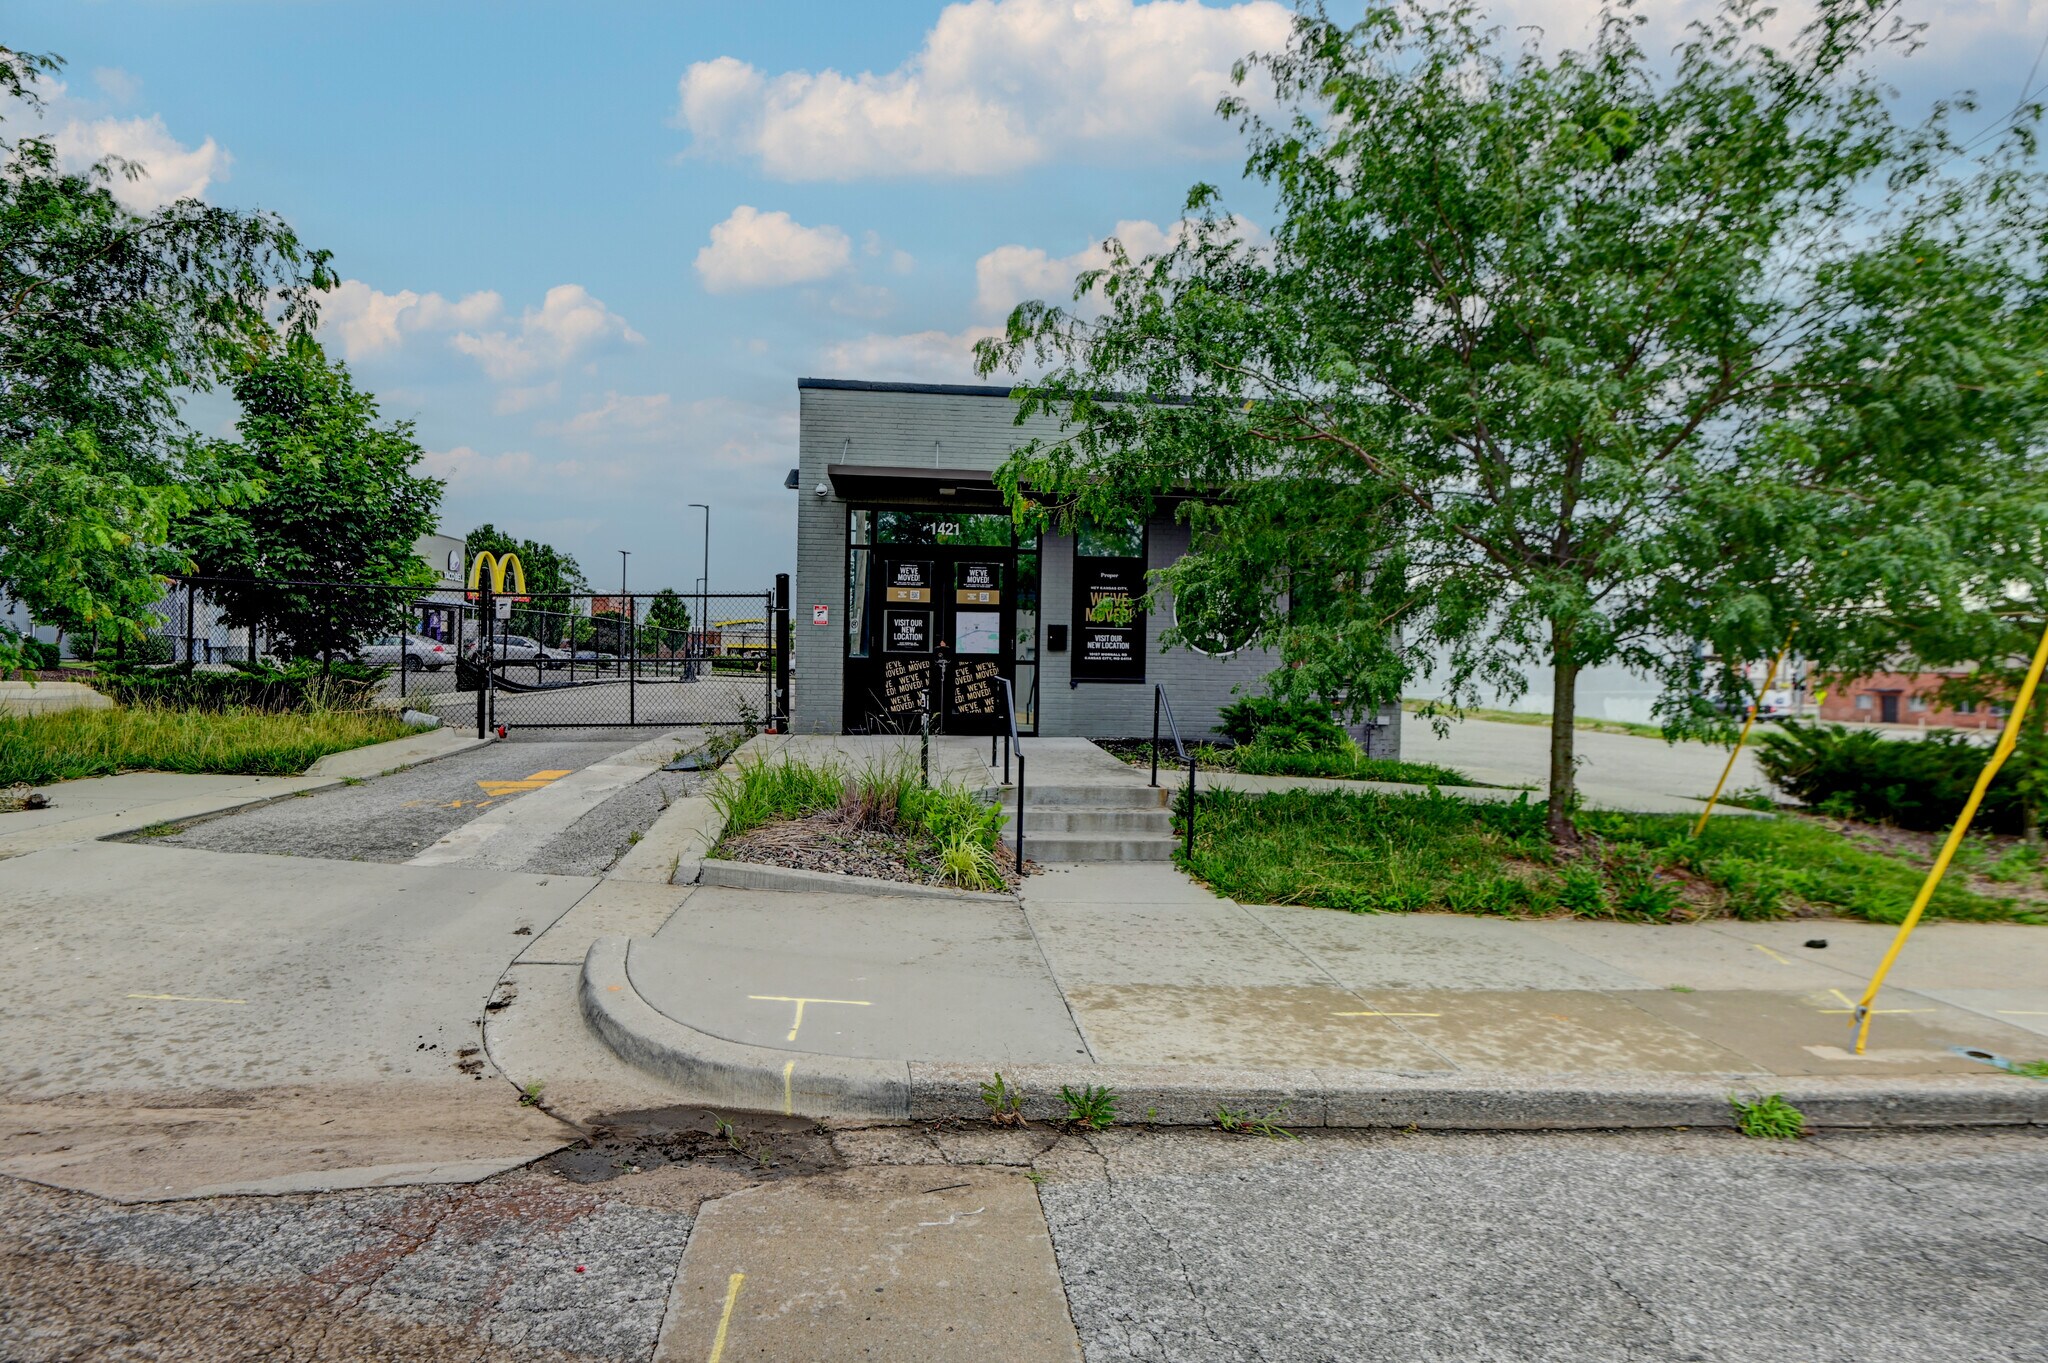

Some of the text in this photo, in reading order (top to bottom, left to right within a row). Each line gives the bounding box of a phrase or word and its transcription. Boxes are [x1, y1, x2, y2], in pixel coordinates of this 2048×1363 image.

[930, 522, 960, 535] 1421
[1086, 608, 1132, 622] MVE!
[976, 662, 996, 671] WE'VE
[899, 673, 919, 684] WE'VE
[976, 667, 1000, 680] MOVED!
[899, 680, 923, 693] MOVED!
[967, 681, 988, 692] WE'VE
[890, 694, 911, 705] WE'VE
[967, 688, 991, 700] MOVED!
[890, 701, 915, 712] MOVED!
[958, 701, 978, 713] WE'VE
